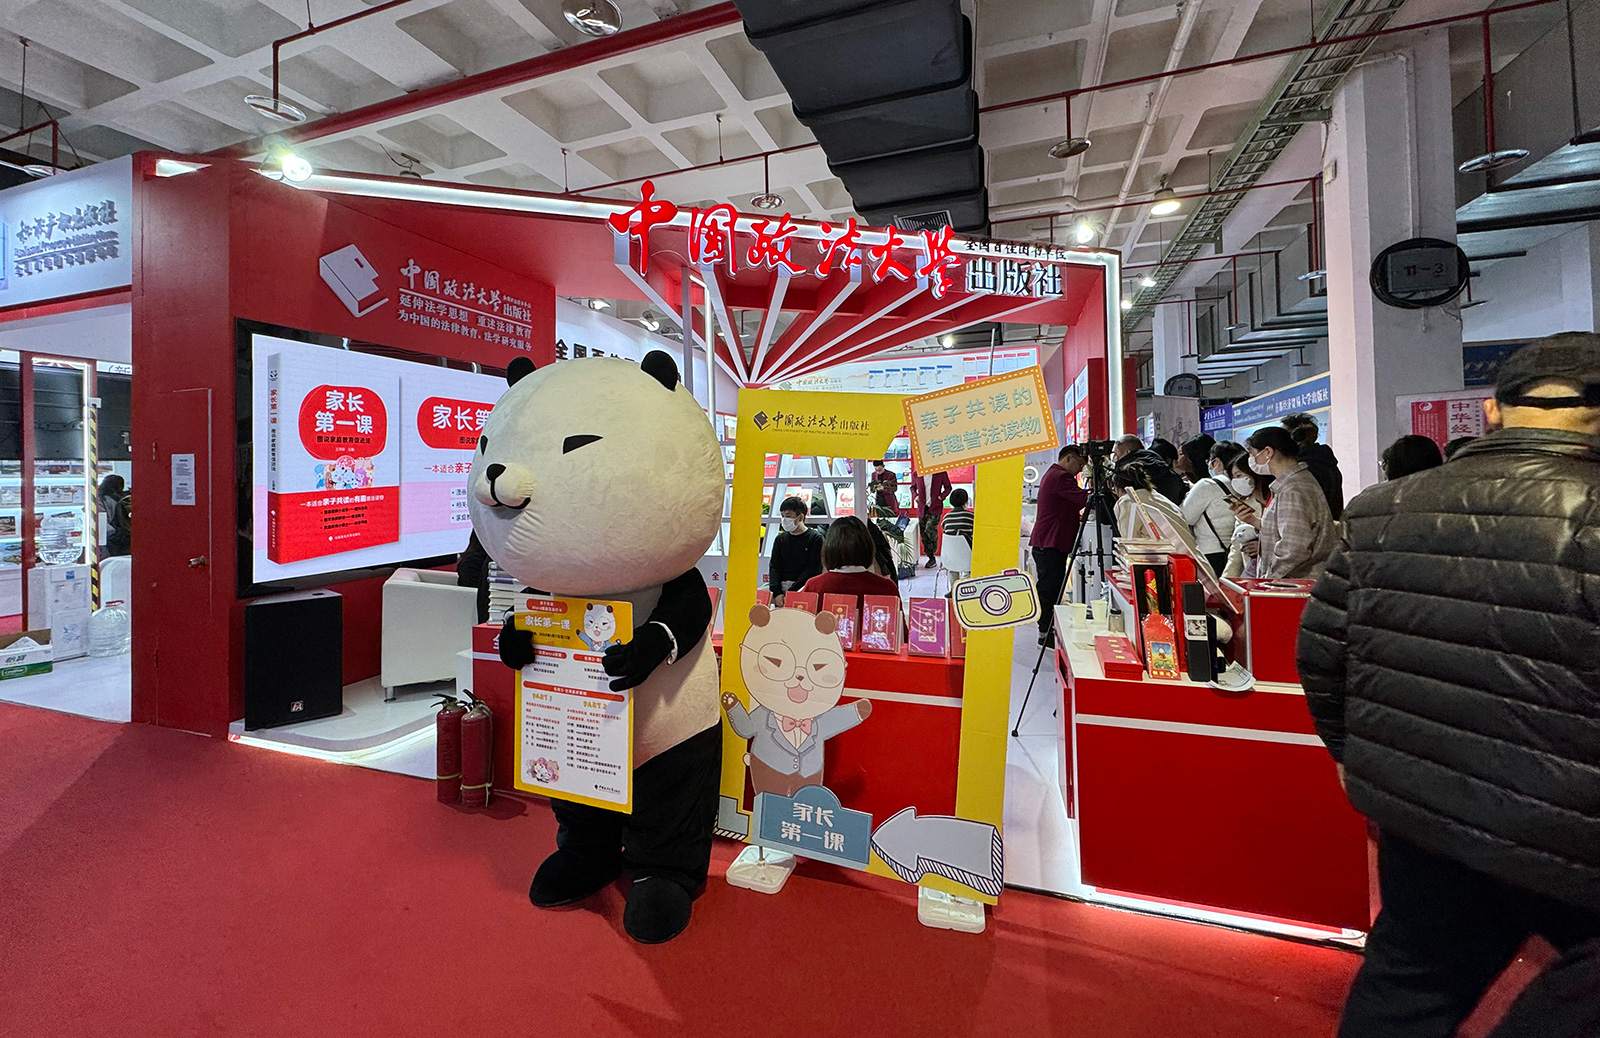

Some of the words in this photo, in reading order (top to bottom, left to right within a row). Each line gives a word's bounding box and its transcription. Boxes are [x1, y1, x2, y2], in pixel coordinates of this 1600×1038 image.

[399, 294, 469, 322] 延伸法学思想
[476, 315, 532, 339] 重述法律教育
[397, 309, 533, 351] 为中国的法律教育、法学研究服务
[325, 389, 364, 412] 家长
[920, 387, 1033, 430] 亲子共读的
[314, 410, 373, 434] 第一课
[772, 411, 870, 430] 中国政法大学出版社
[316, 435, 371, 444] 图说家庭教育促进法
[925, 416, 1042, 458] 有趣普法读物
[525, 615, 571, 631] 家长第一课
[532, 693, 548, 701] PART
[583, 701, 602, 709] PART
[792, 802, 835, 828] 家长
[781, 820, 844, 853] 第一课
